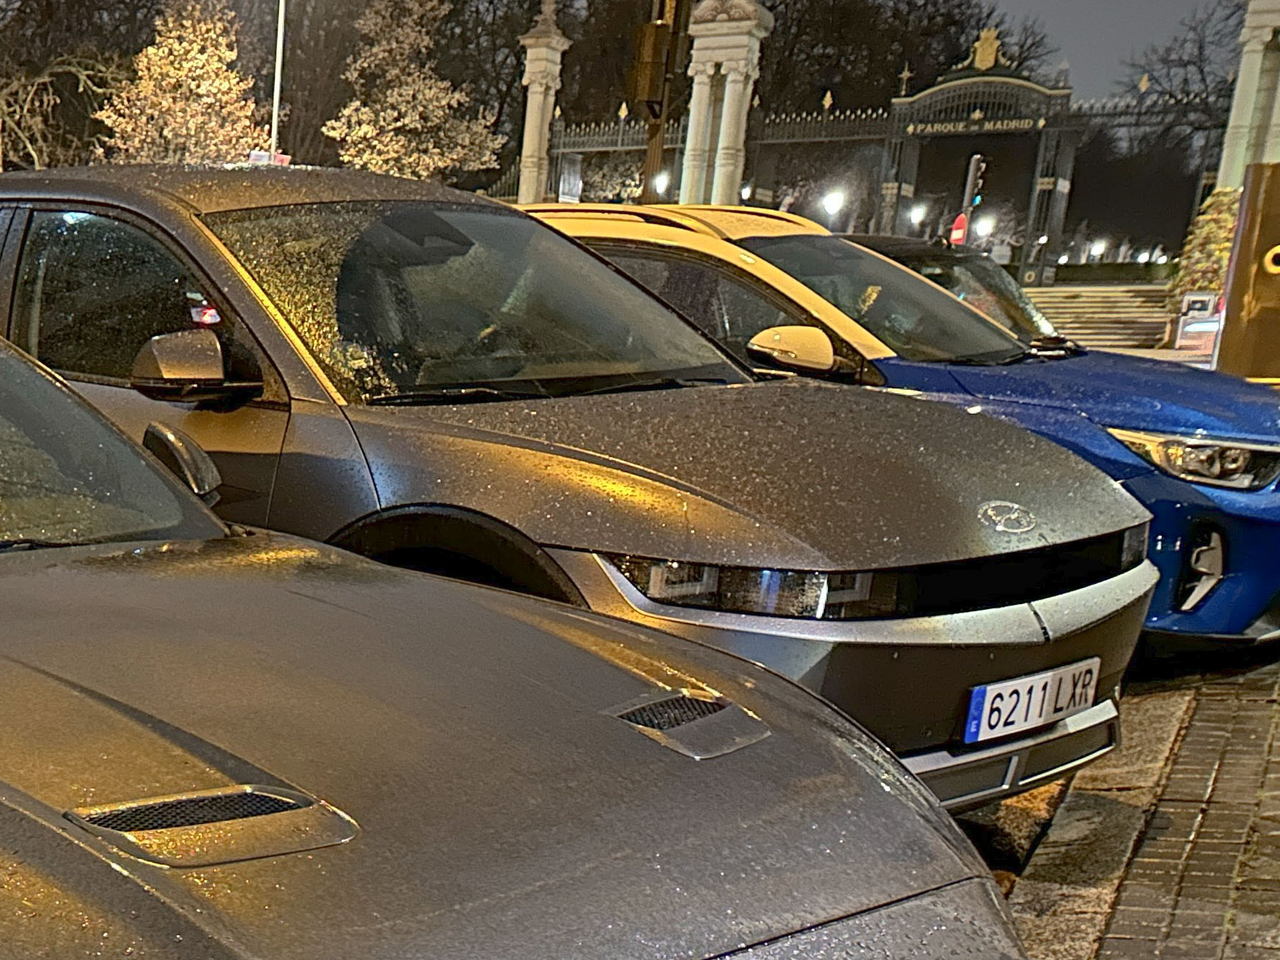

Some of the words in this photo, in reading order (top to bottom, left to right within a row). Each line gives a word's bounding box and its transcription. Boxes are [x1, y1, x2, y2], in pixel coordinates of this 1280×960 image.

[917, 121, 967, 133] PARQUE
[983, 118, 1034, 131] MADRID
[987, 680, 1049, 731] 6211
[1052, 668, 1094, 714] LXR
